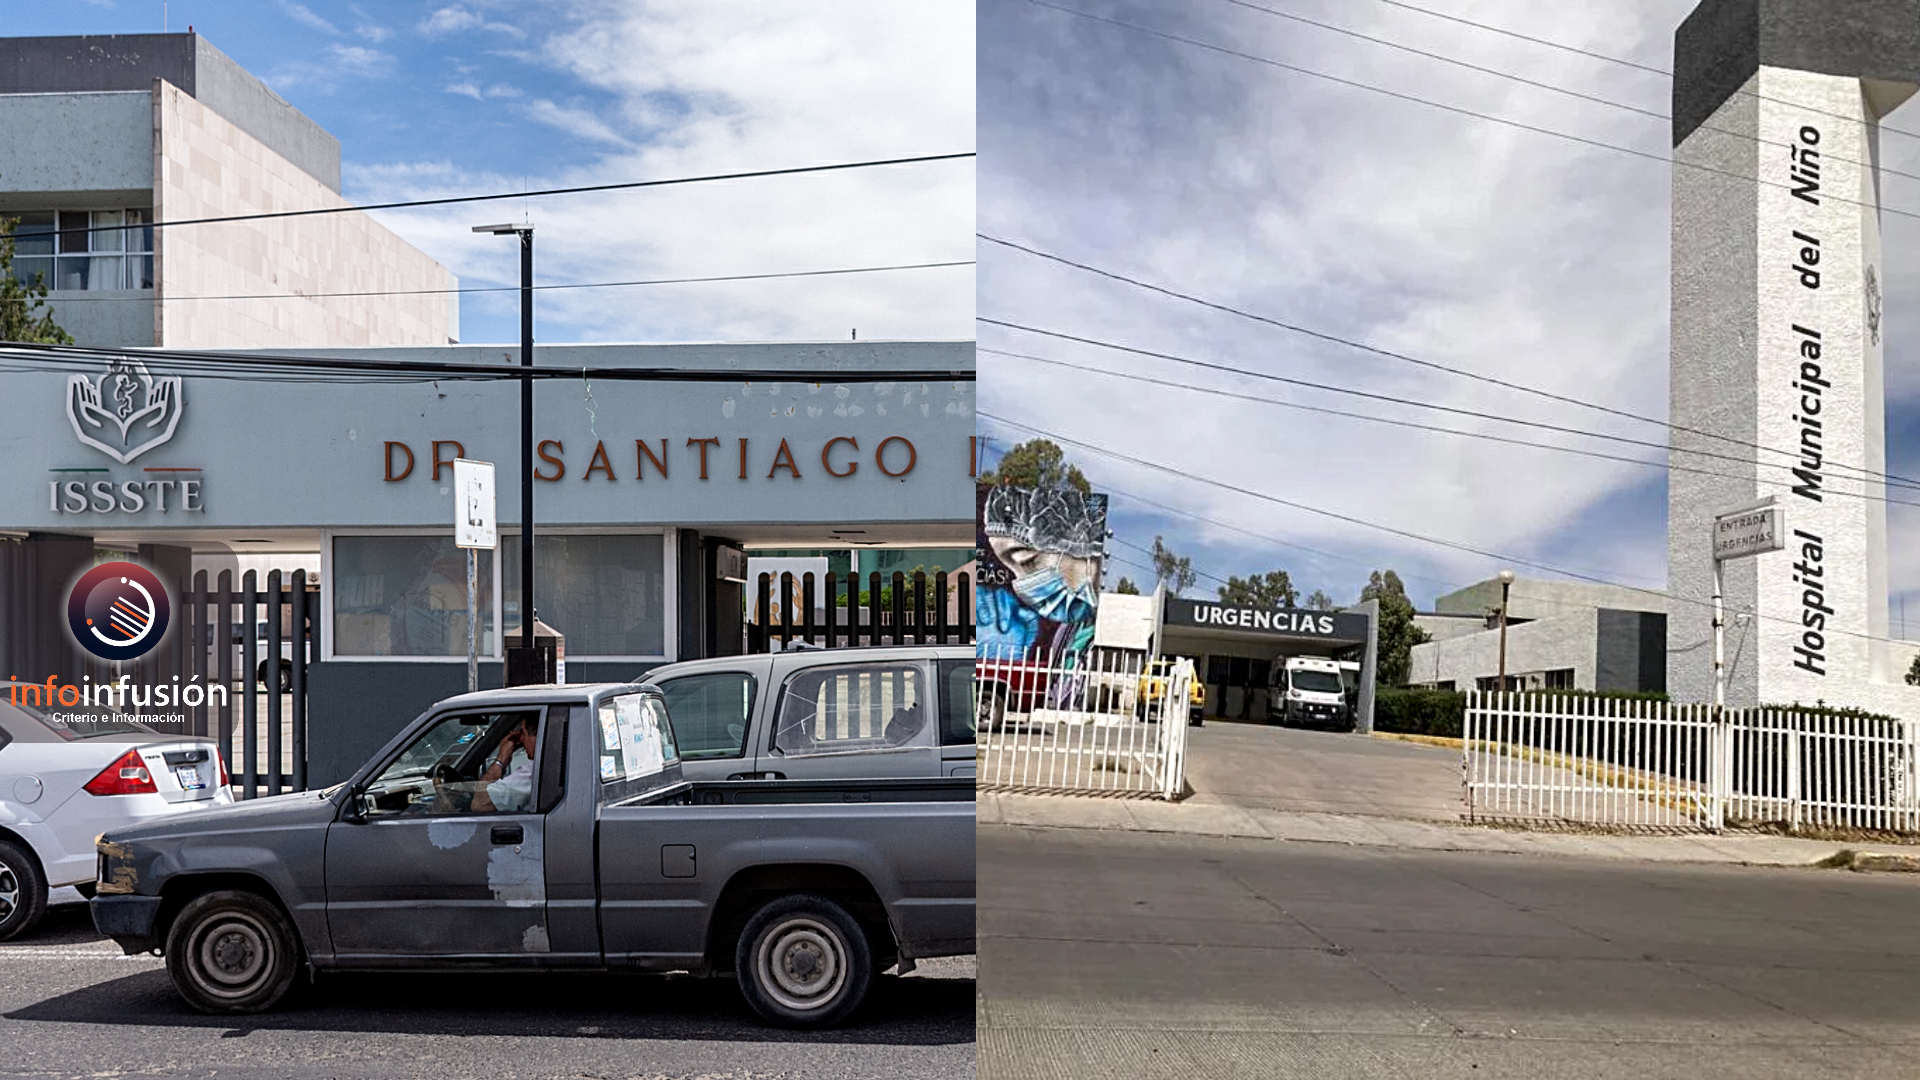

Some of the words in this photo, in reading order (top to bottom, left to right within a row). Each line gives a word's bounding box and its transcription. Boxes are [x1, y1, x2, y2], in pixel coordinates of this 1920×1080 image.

[1790, 125, 1821, 206] Niño
[1792, 230, 1821, 290] del
[1792, 323, 1831, 503] Municipal
[534, 435, 918, 482] SANTIAGO
[48, 480, 205, 514] ISSSTE
[1716, 531, 1773, 552] URGENCIAS
[1720, 514, 1767, 532] ENTRADA
[1193, 605, 1334, 634] URGENCIAS
[1793, 529, 1835, 676] Hospital
